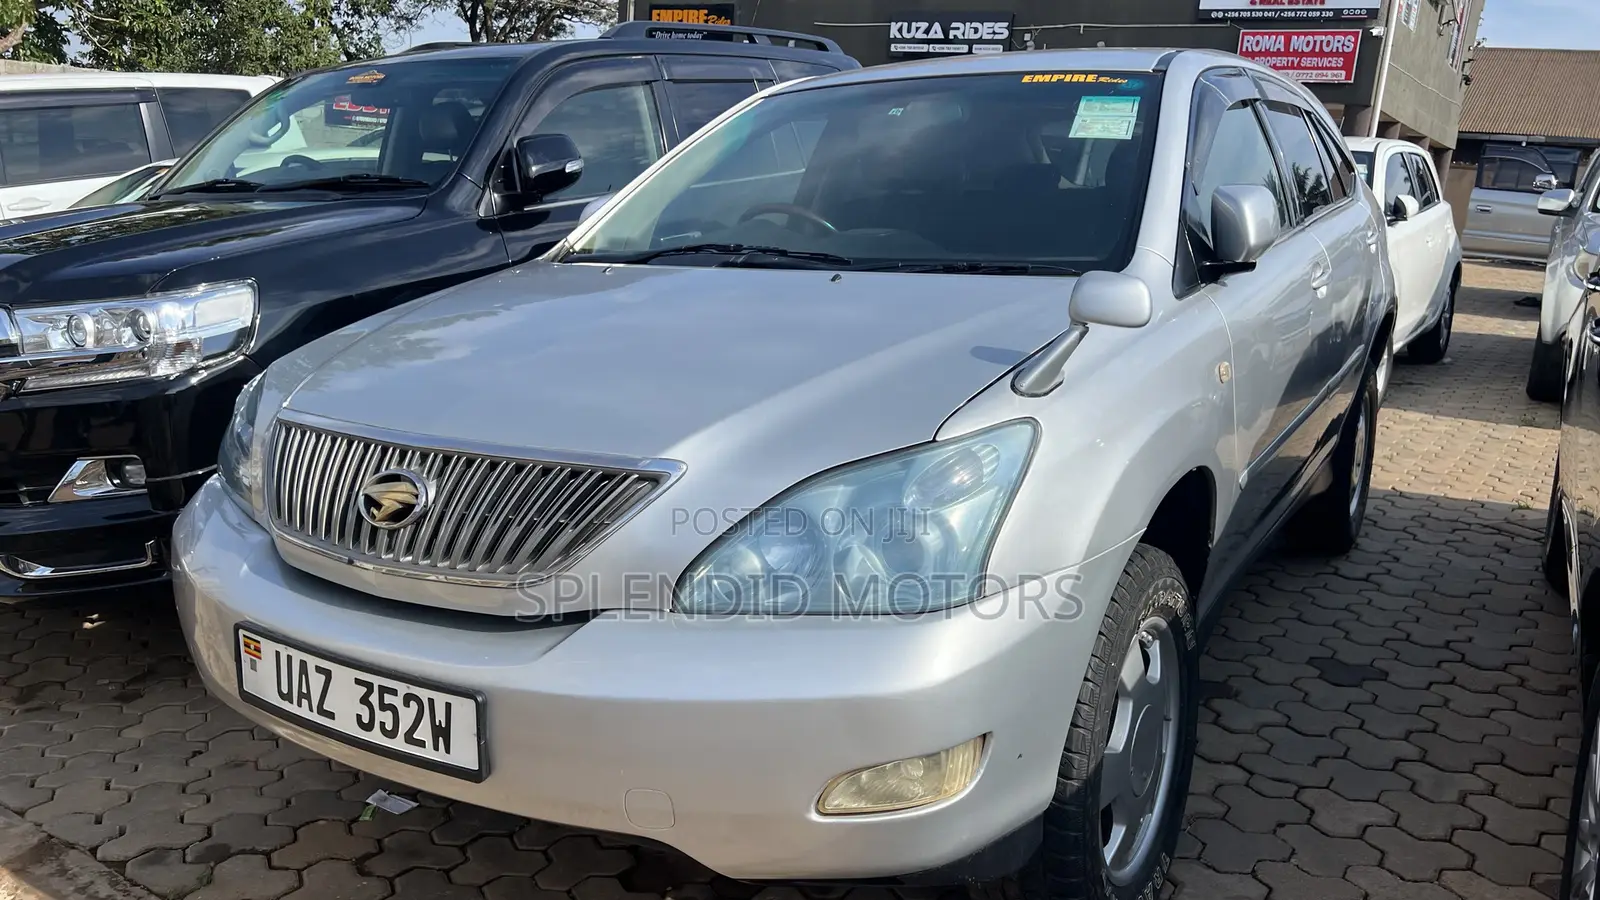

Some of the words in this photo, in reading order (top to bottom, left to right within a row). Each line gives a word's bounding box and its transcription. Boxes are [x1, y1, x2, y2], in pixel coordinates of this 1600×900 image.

[652, 9, 708, 24] EMPIRE
[671, 31, 687, 39] home
[890, 22, 944, 39] KUZA
[949, 22, 1009, 40] RIDES
[1242, 35, 1285, 52] ROMA
[1289, 35, 1354, 53] MOTORS
[1255, 57, 1300, 67] PROPERTY
[1300, 57, 1344, 67] SERVICES
[1021, 74, 1098, 83] EMPIRE
[275, 650, 336, 720] UAZ
[354, 677, 452, 755] 352W
